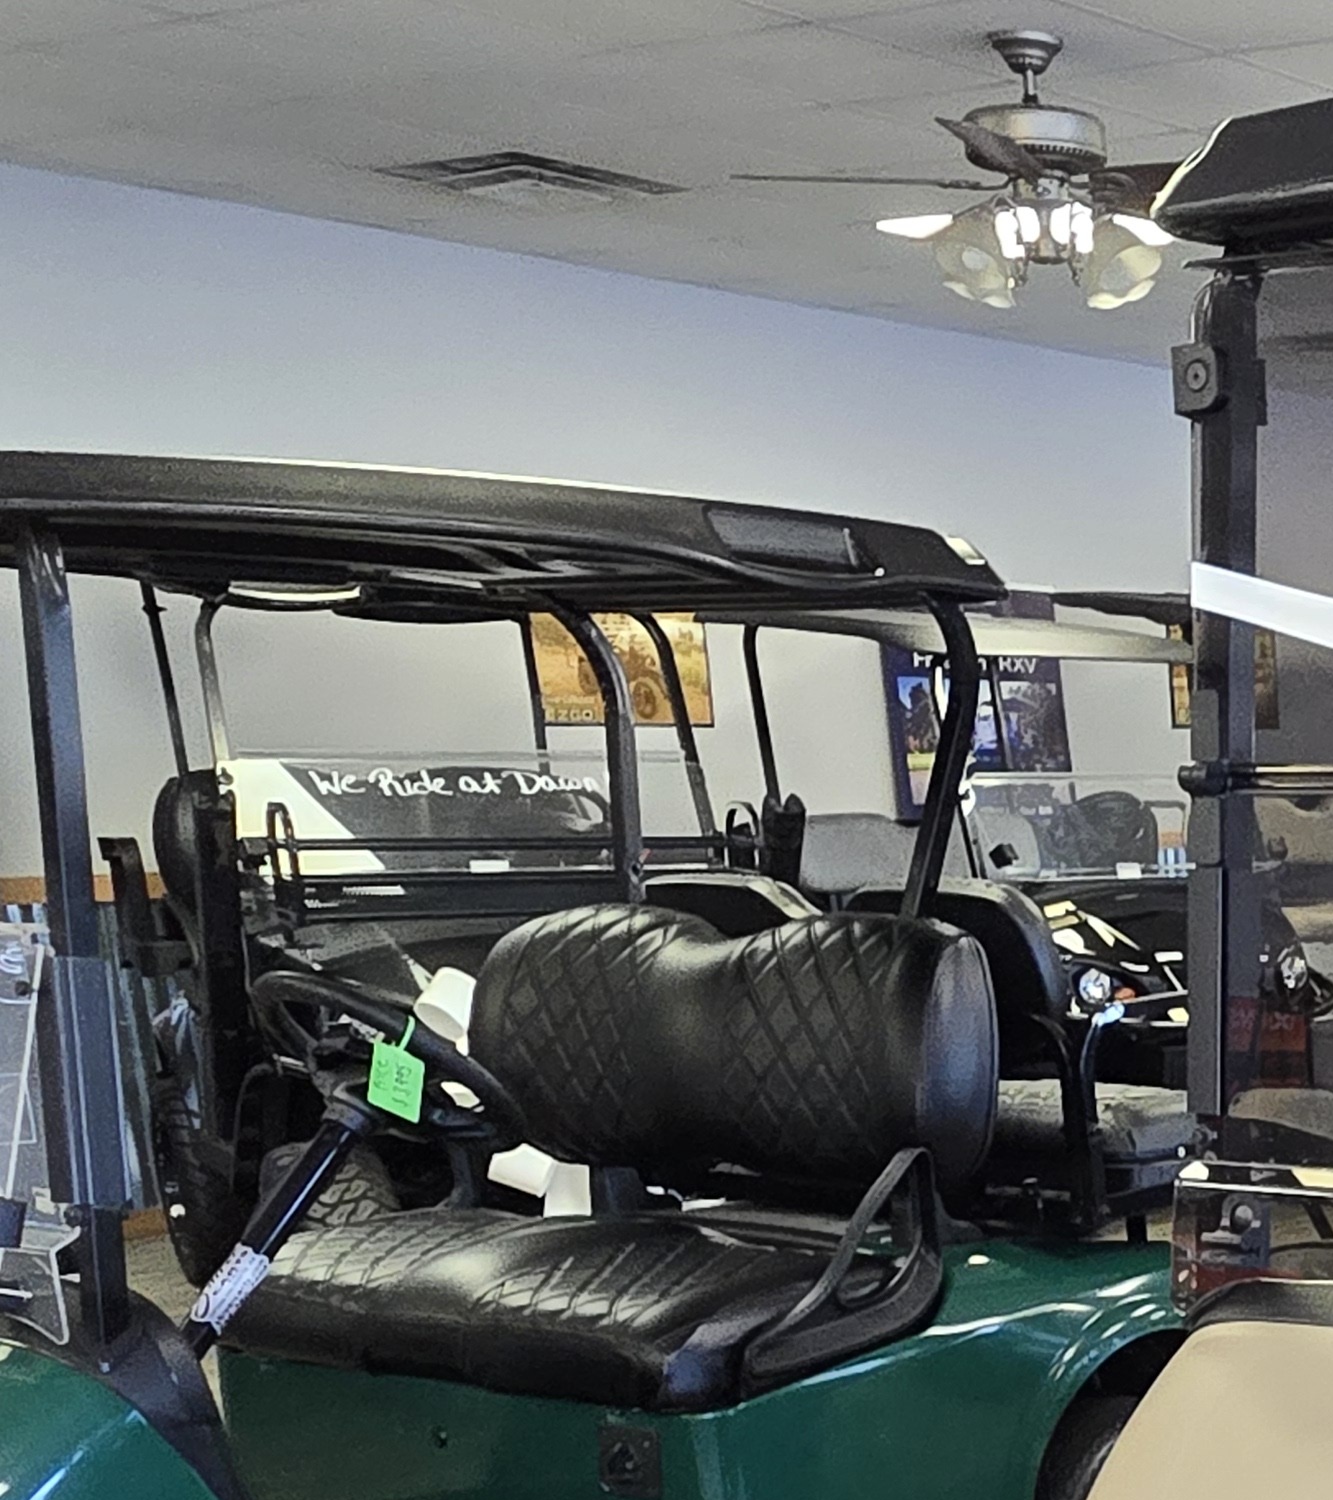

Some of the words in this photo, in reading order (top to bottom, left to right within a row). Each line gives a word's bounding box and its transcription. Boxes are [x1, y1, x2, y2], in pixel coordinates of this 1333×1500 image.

[308, 769, 366, 797] We
[367, 768, 453, 798] Ride
[458, 771, 503, 796] at
